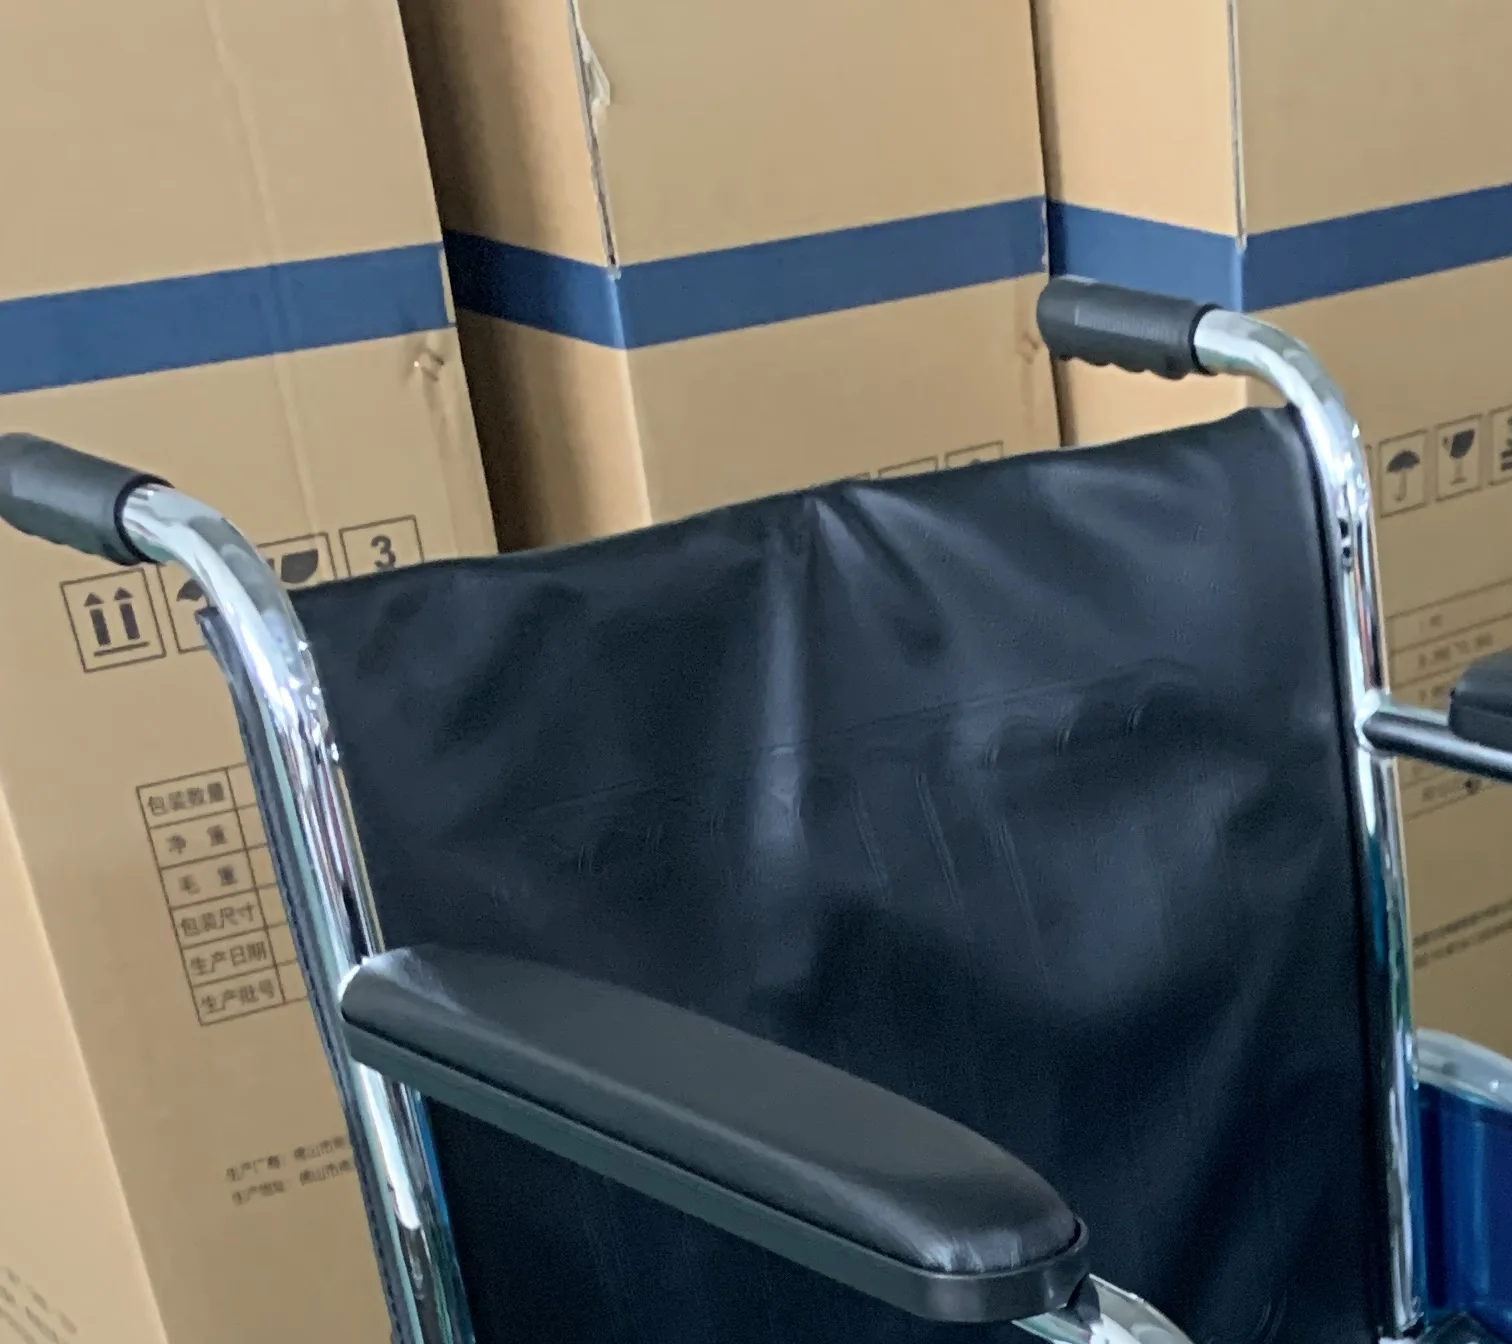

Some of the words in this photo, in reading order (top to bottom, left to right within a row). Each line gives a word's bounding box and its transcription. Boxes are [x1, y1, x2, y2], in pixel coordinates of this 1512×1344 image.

[371, 535, 397, 571] 3
[180, 902, 256, 936] 包装尺寸
[190, 941, 268, 976] 生产日期
